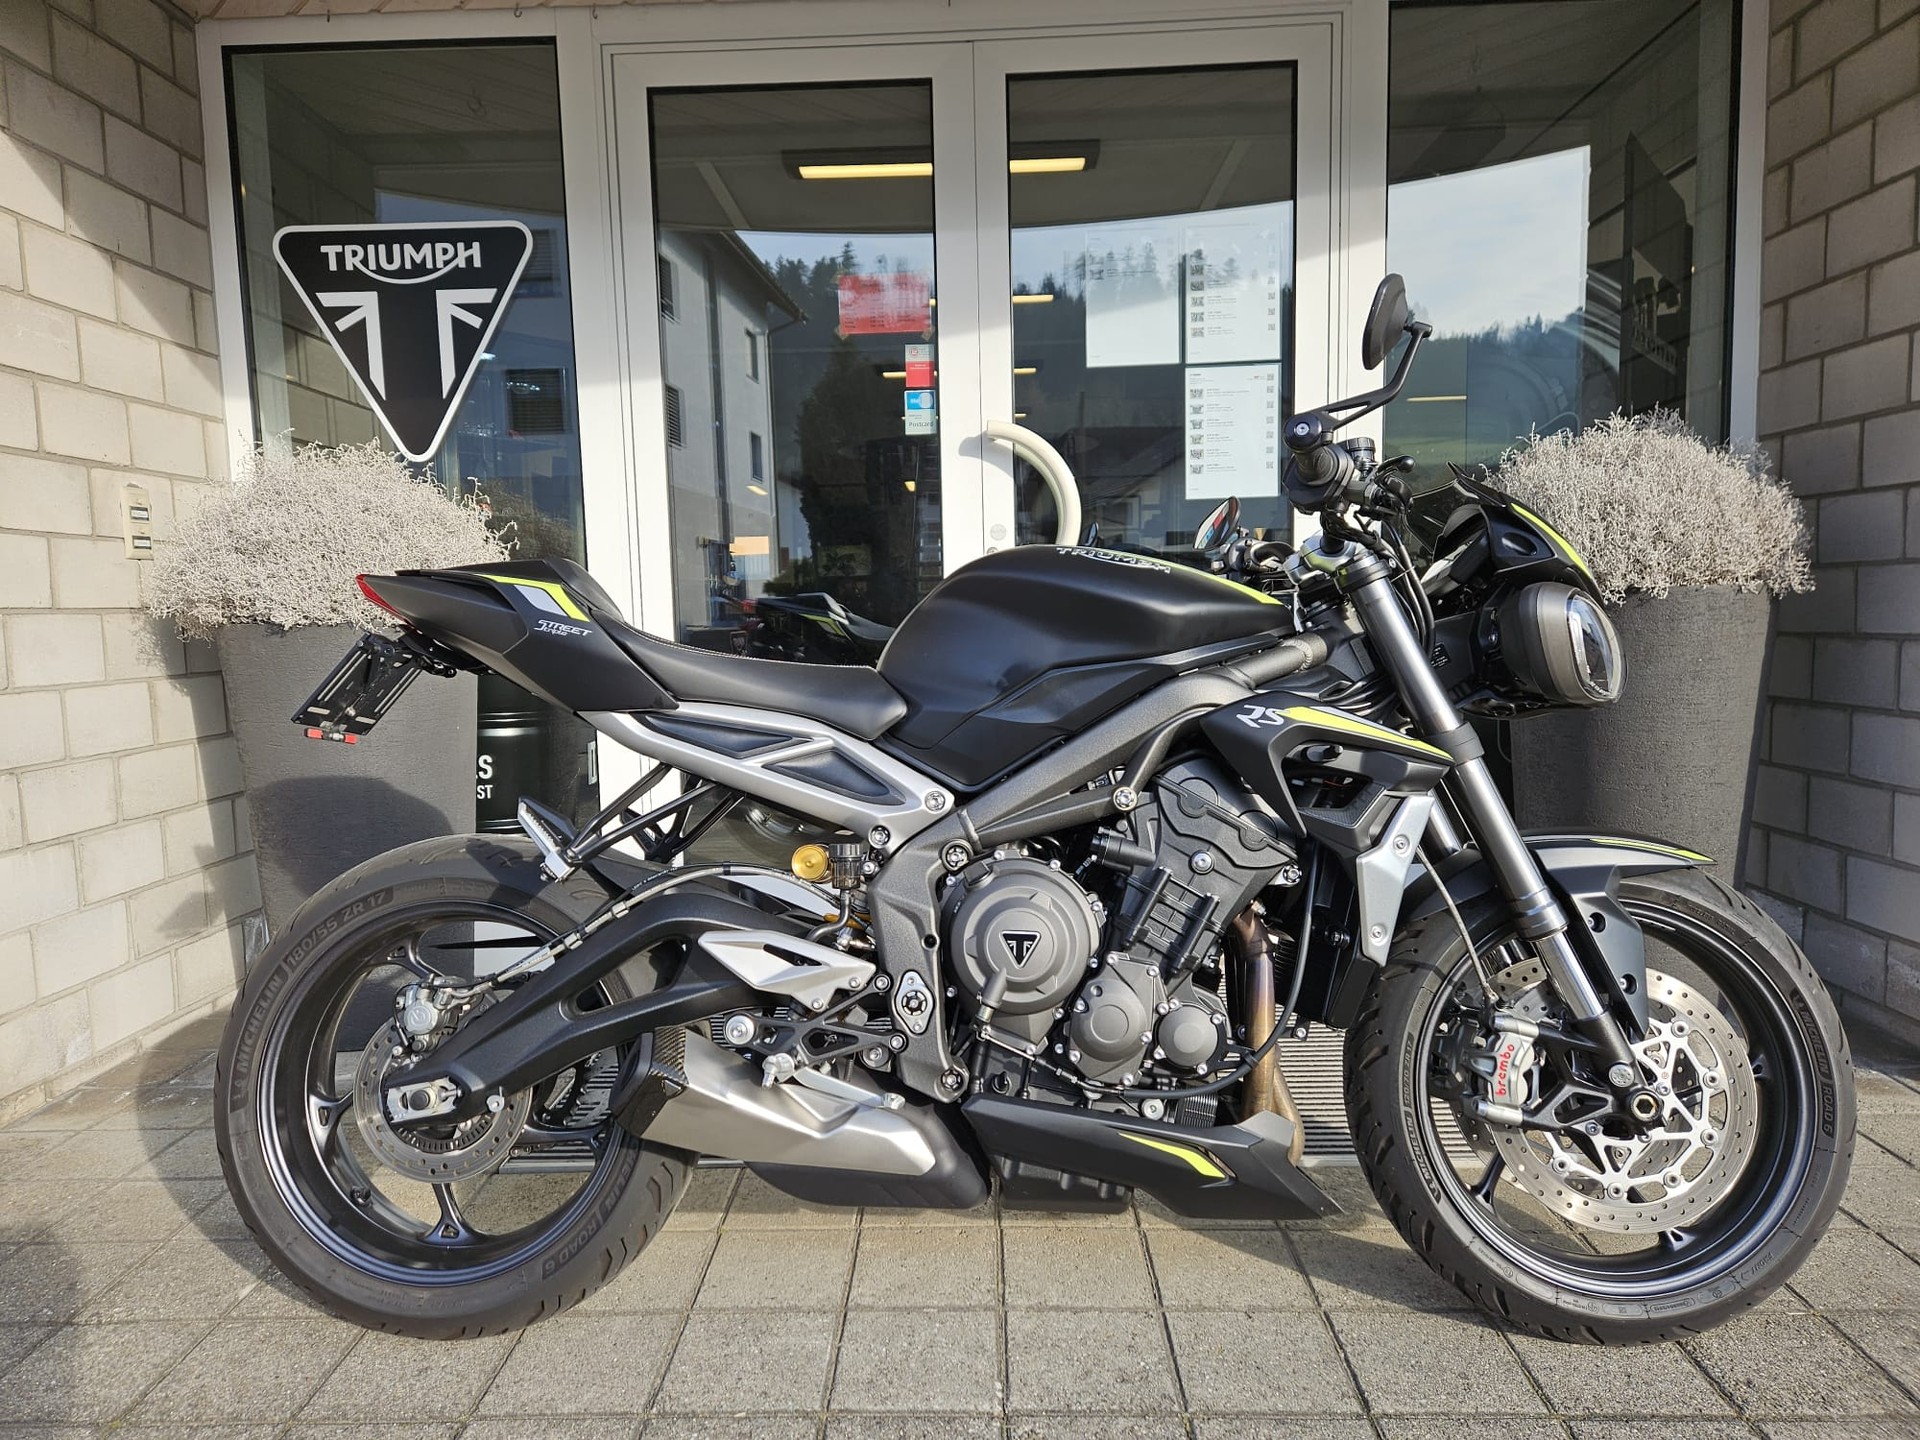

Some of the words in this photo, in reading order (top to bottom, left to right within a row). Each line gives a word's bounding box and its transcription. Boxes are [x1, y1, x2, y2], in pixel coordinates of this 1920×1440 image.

[320, 241, 482, 284] TRIUMPH
[1056, 547, 1171, 574] TRIUMPH
[533, 619, 593, 637] STREET
[1236, 704, 1286, 729] RS
[237, 975, 285, 1071] MICHELIN
[287, 918, 338, 968] 180/55
[343, 903, 365, 922] ZR
[367, 892, 386, 908] 17
[1800, 1010, 1830, 1076] MICHELIN
[1495, 1044, 1515, 1096] brembo
[1822, 1085, 1833, 1121] ROAD
[1823, 1123, 1833, 1133] 6
[1406, 1116, 1432, 1180] MICHELIN
[558, 1213, 598, 1263] ROAD
[544, 1261, 557, 1273] 6
